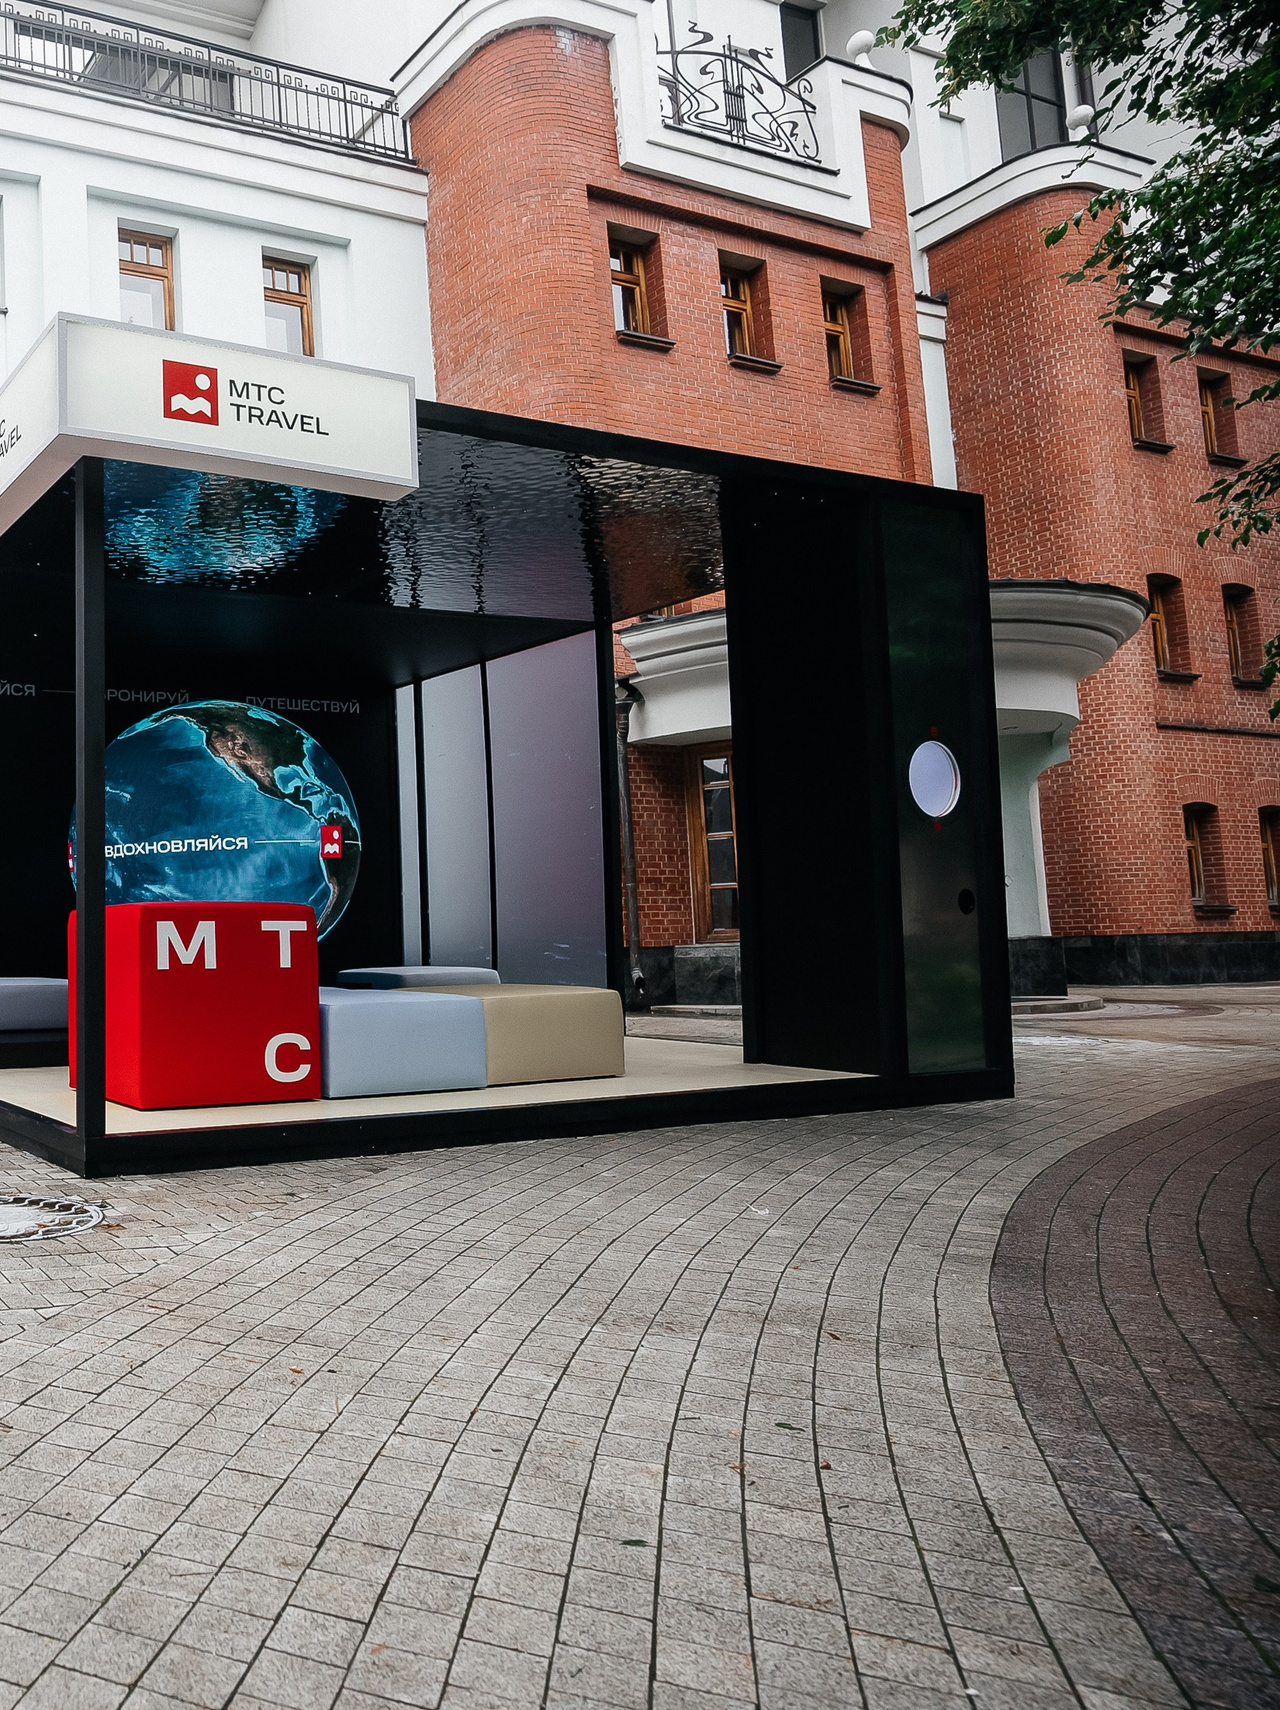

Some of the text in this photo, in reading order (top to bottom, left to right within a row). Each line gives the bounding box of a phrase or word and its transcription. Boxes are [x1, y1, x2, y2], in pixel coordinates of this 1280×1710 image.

[229, 402, 330, 436] TRAVEL
[103, 688, 189, 704] РОНИРУЙ
[245, 696, 360, 714] ПУТЕШЕСТВУЙ
[105, 834, 249, 859] ВДОХНОВЛЯЙСЯ
